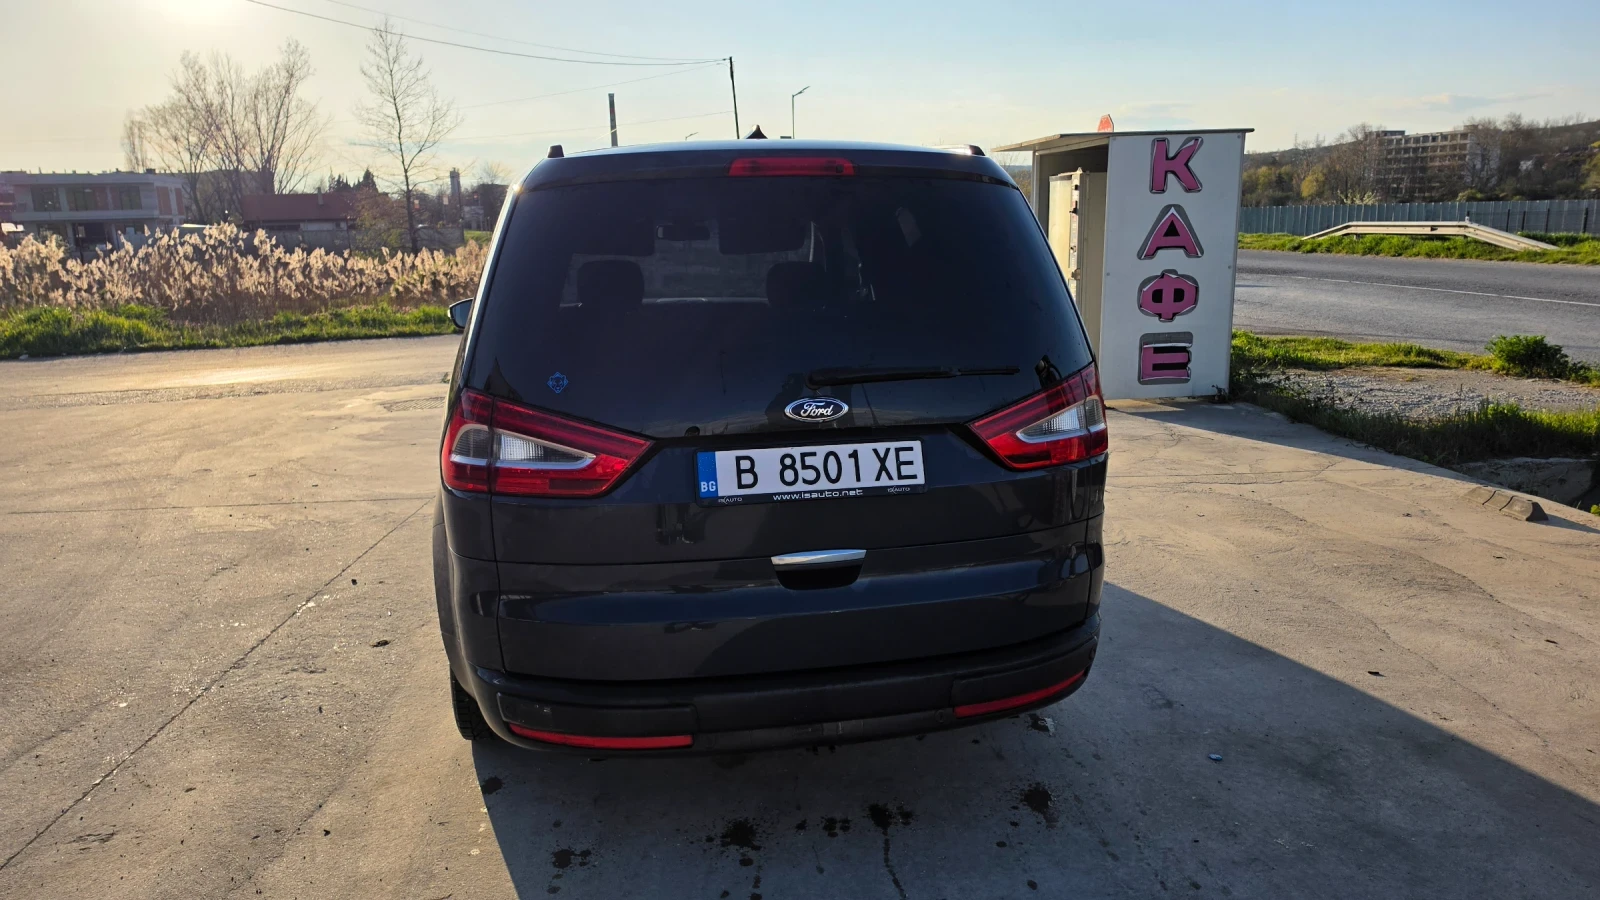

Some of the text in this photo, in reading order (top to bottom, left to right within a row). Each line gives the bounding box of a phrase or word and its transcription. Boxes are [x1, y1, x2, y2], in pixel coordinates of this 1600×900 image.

[1137, 137, 1204, 385] КАФЕ
[800, 402, 834, 417] Ford
[735, 447, 918, 489] B 8501 XE
[700, 481, 716, 493] BG
[772, 489, 864, 501] www.isauto.net
